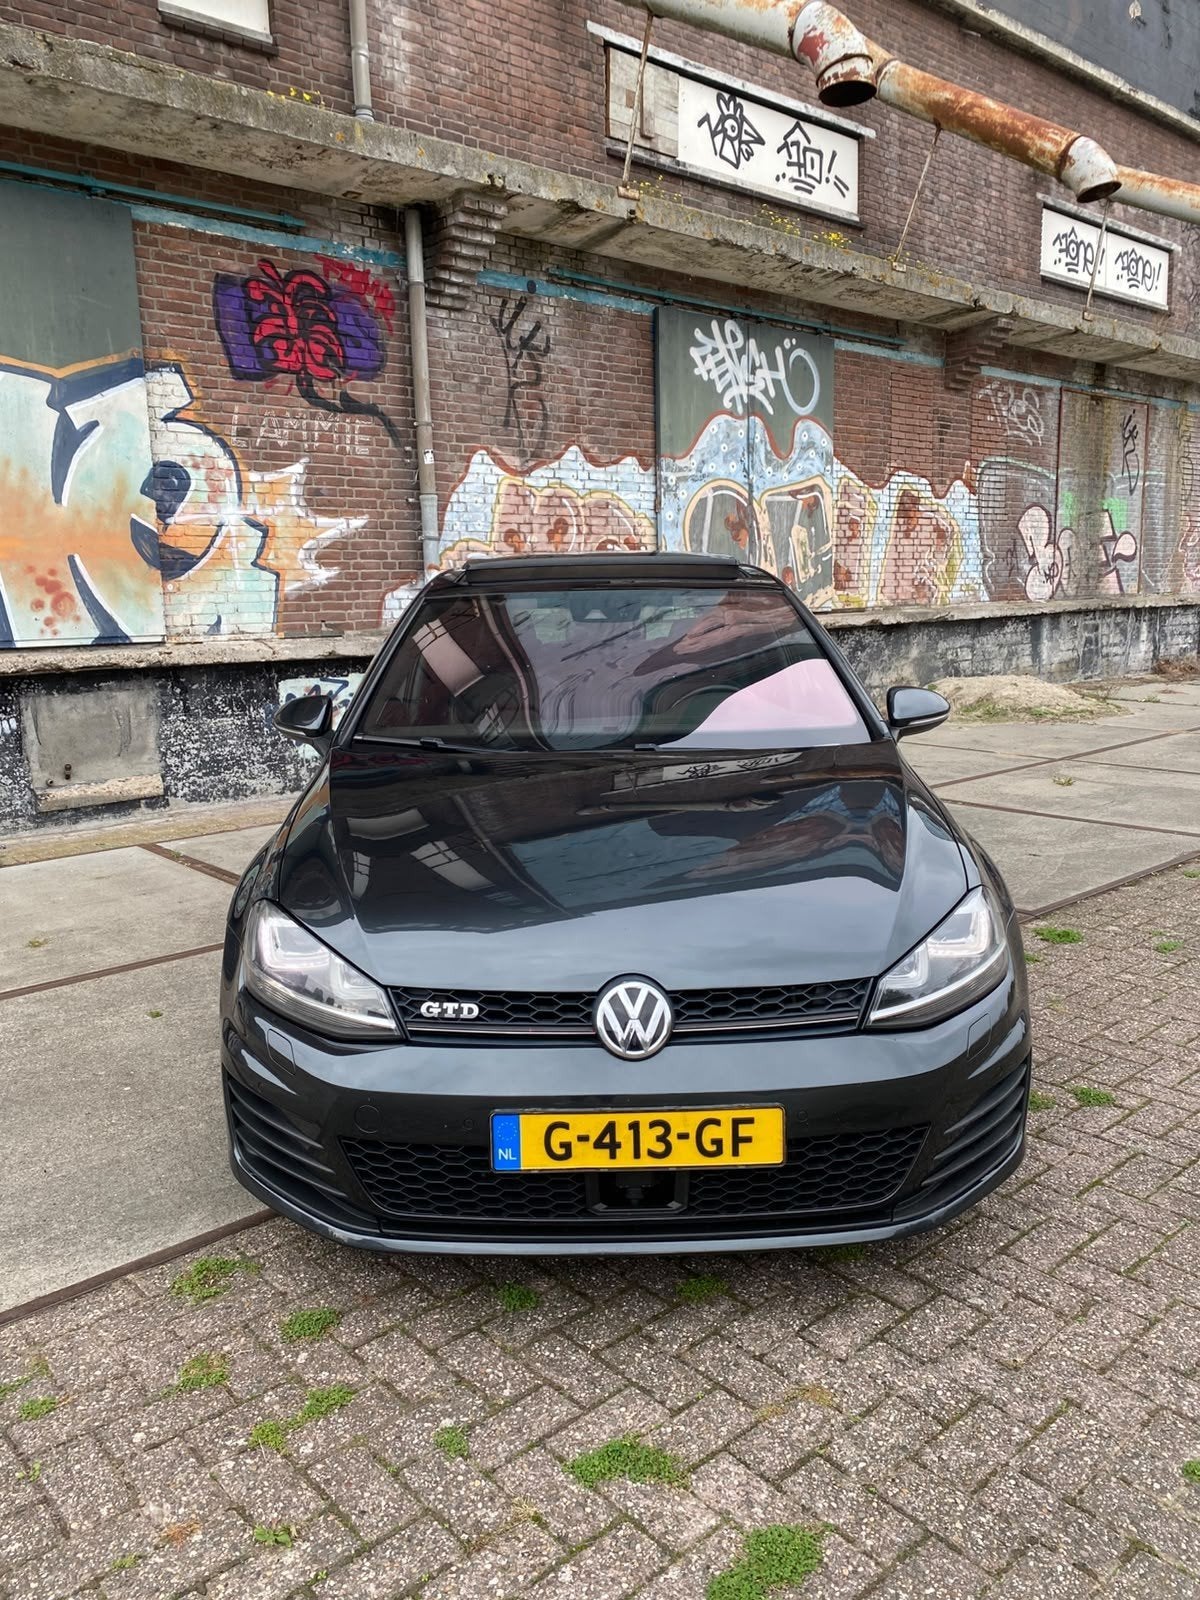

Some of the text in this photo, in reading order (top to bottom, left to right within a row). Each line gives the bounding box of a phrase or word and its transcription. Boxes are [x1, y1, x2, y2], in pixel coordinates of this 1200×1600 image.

[231, 405, 373, 455] LAMMIE
[420, 1001, 480, 1019] GTD
[598, 983, 670, 1056] VW
[498, 1148, 517, 1161] NL
[543, 1116, 755, 1161] G-413-GF
